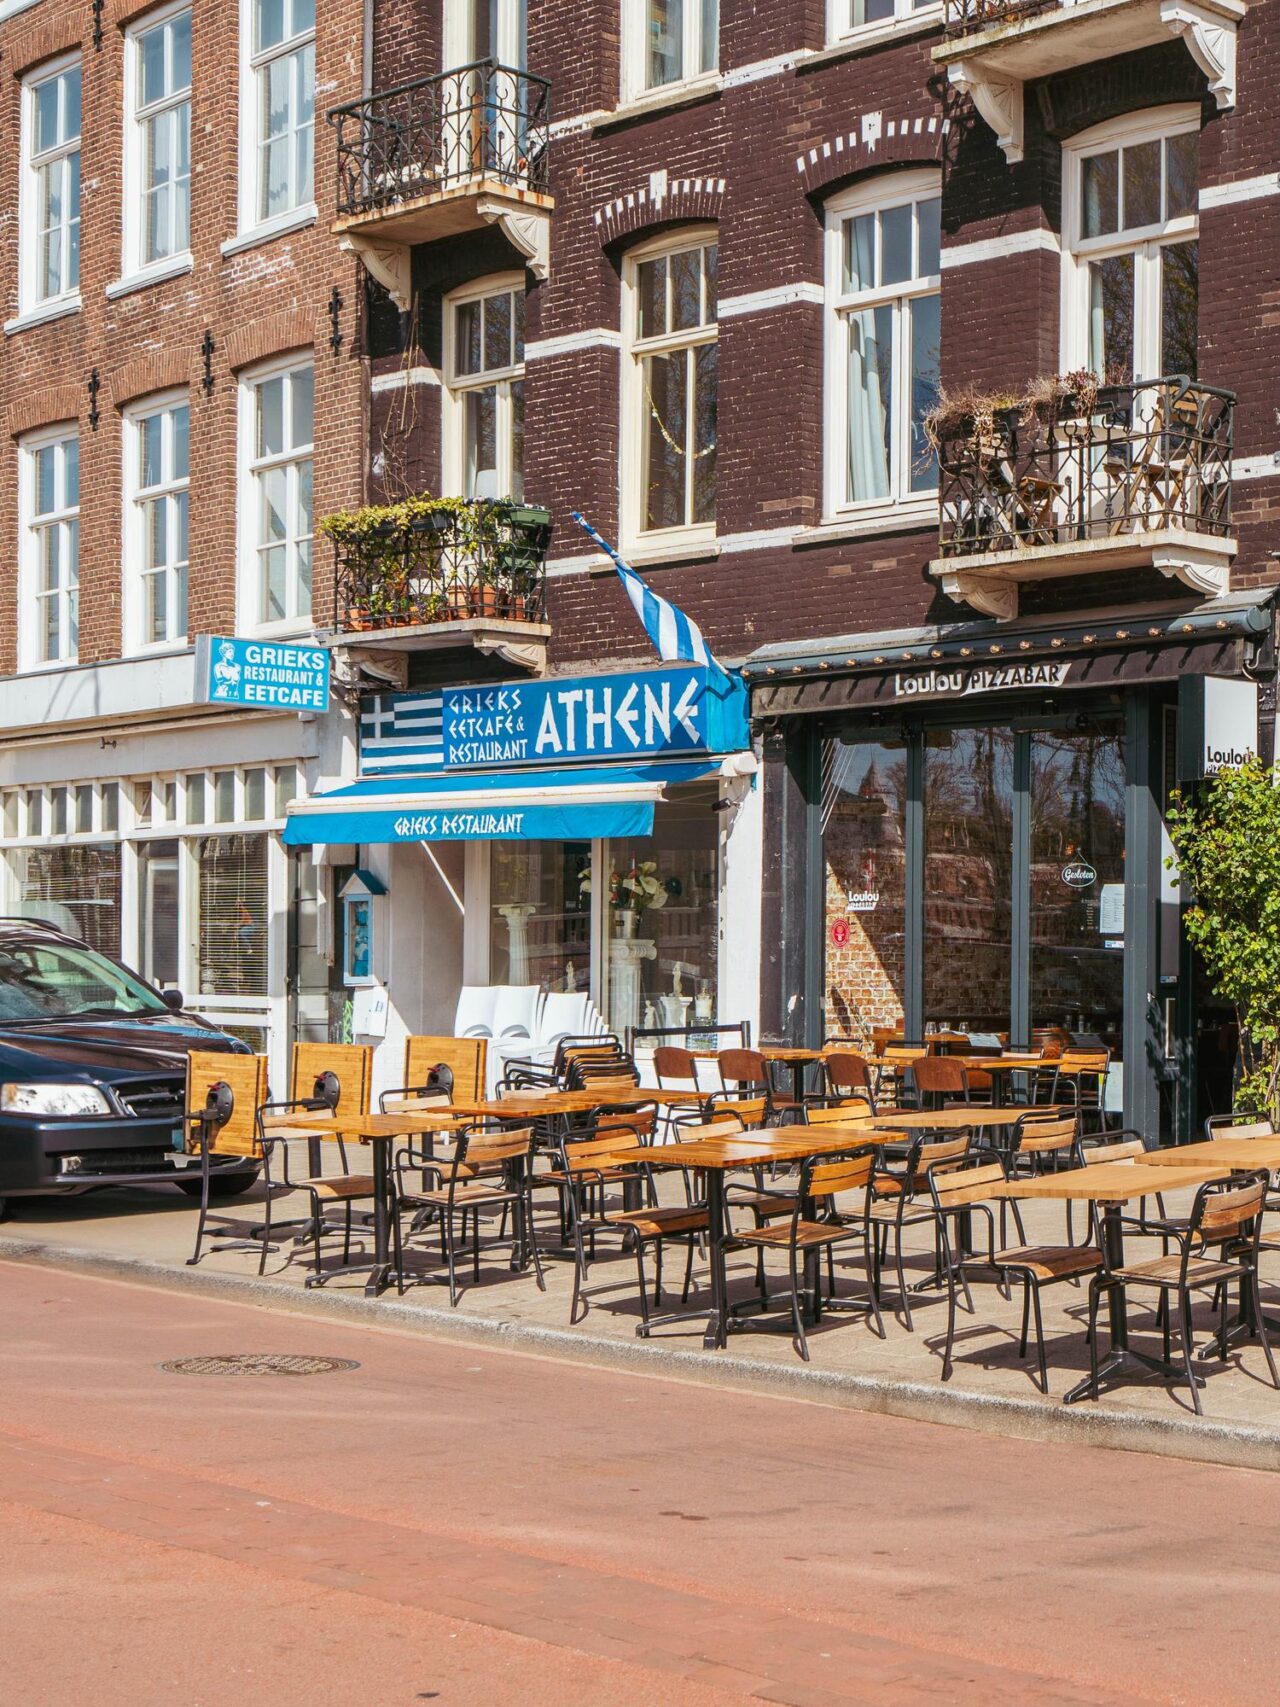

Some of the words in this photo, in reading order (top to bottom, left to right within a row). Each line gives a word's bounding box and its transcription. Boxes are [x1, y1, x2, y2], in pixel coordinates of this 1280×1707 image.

[245, 645, 325, 670] GRIEKS
[244, 665, 314, 686] RESTAURANT
[316, 672, 324, 687] &
[895, 670, 962, 696] Loulou
[971, 664, 1060, 690] PIZZABAR
[244, 684, 324, 706] EETCAFE
[448, 688, 522, 714] GRIEKS
[516, 717, 525, 732] &
[534, 676, 701, 753] ATHENE
[449, 738, 528, 763] RESTAURANT
[394, 815, 438, 836] GRIEKS
[441, 813, 524, 835] RESTAURANT
[848, 891, 880, 902] Loulou
